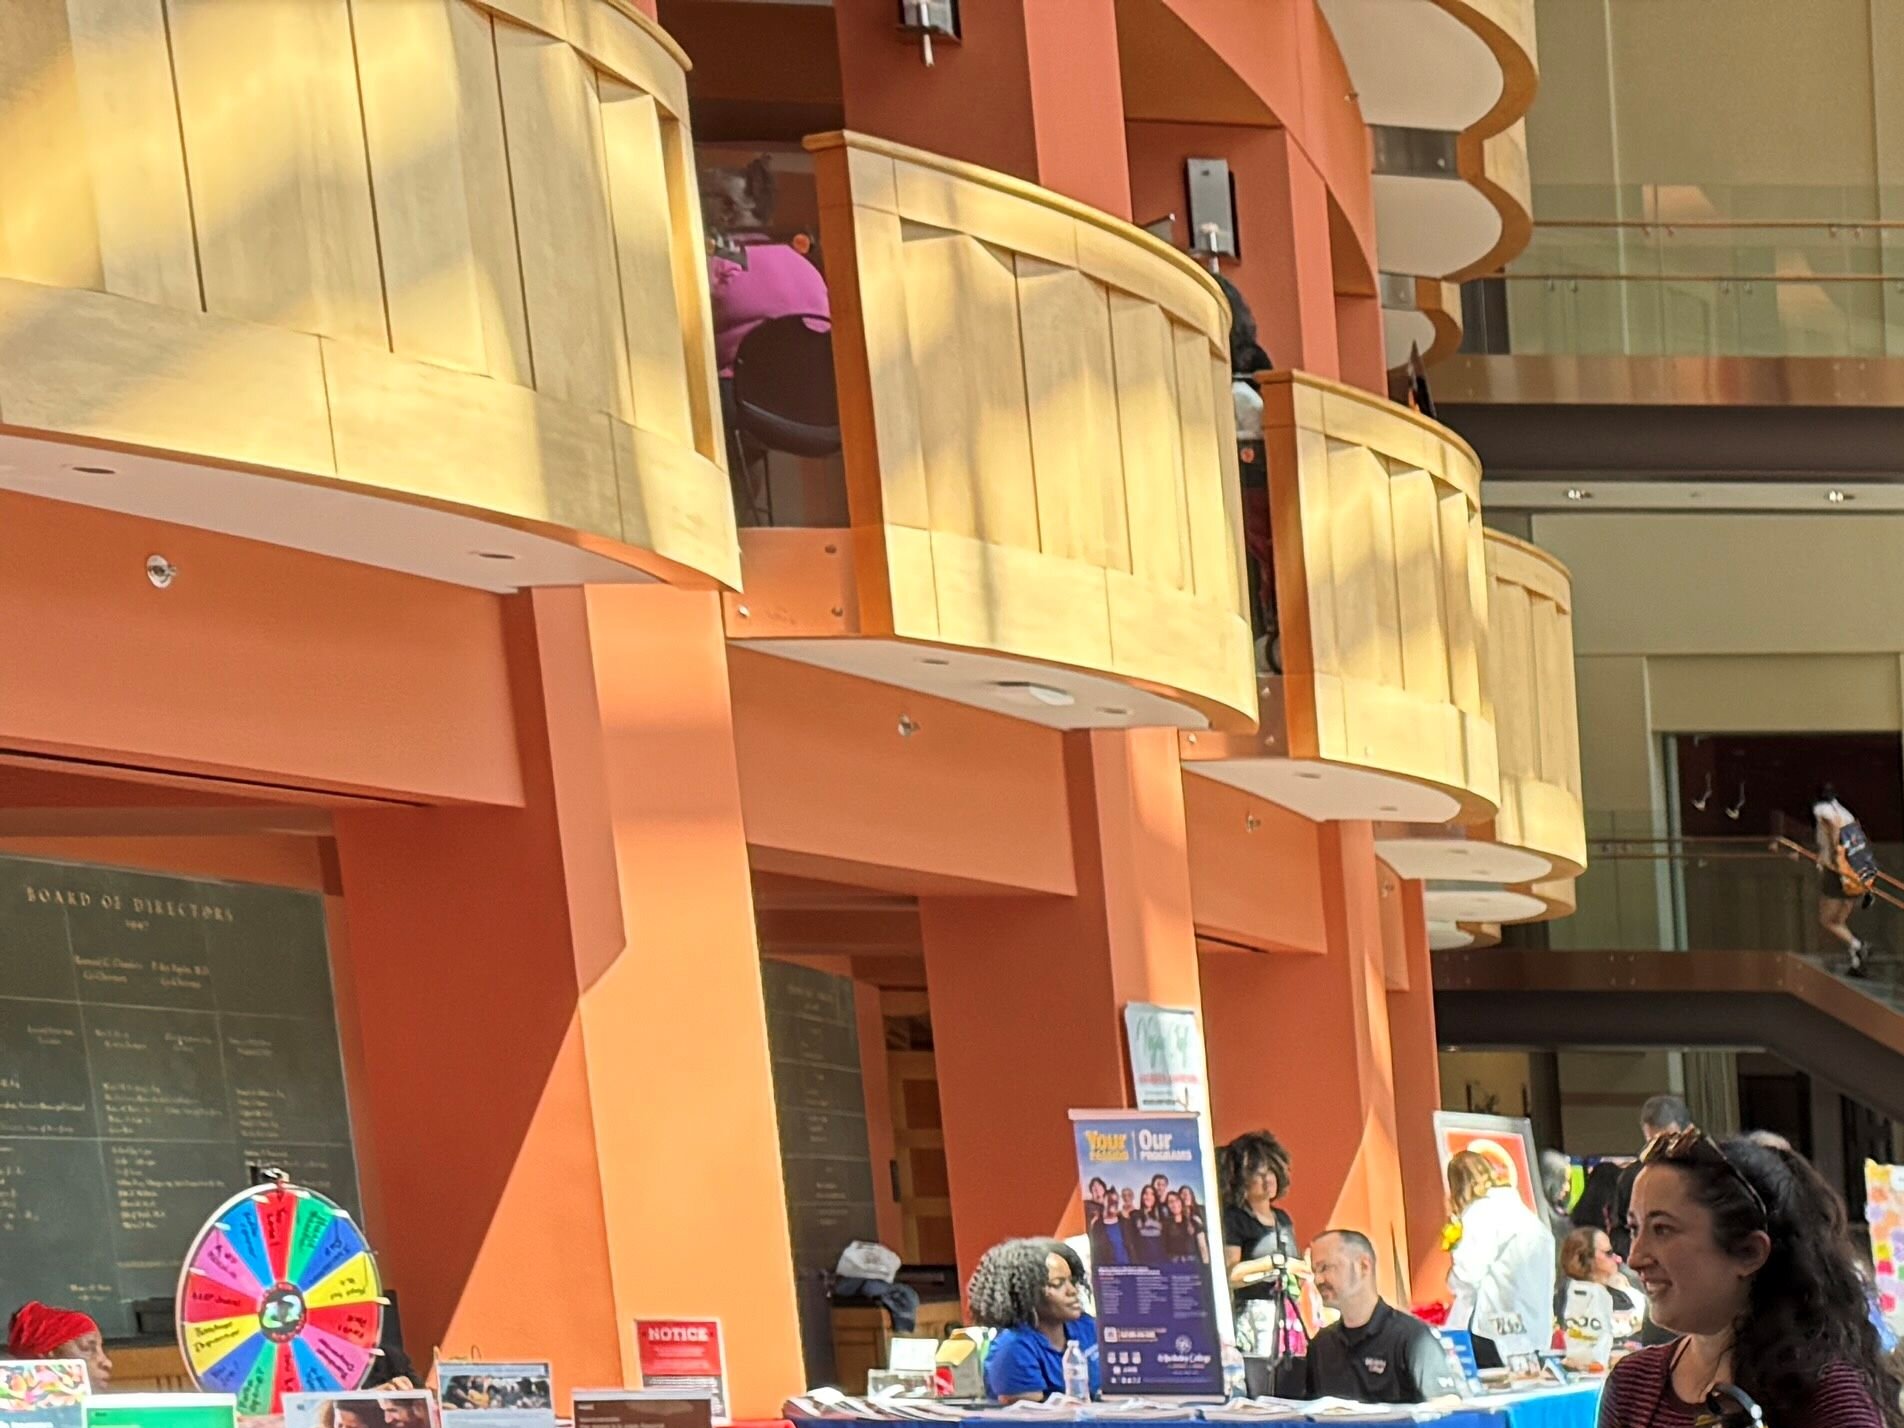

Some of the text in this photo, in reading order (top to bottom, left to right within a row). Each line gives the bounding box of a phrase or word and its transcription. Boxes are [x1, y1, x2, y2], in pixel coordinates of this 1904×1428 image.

[26, 886, 90, 907] BOARD
[133, 897, 234, 923] DIRECTORS
[1085, 1130, 1127, 1151] Your
[1139, 1128, 1172, 1151] Our
[648, 1326, 709, 1343] NOTICE
